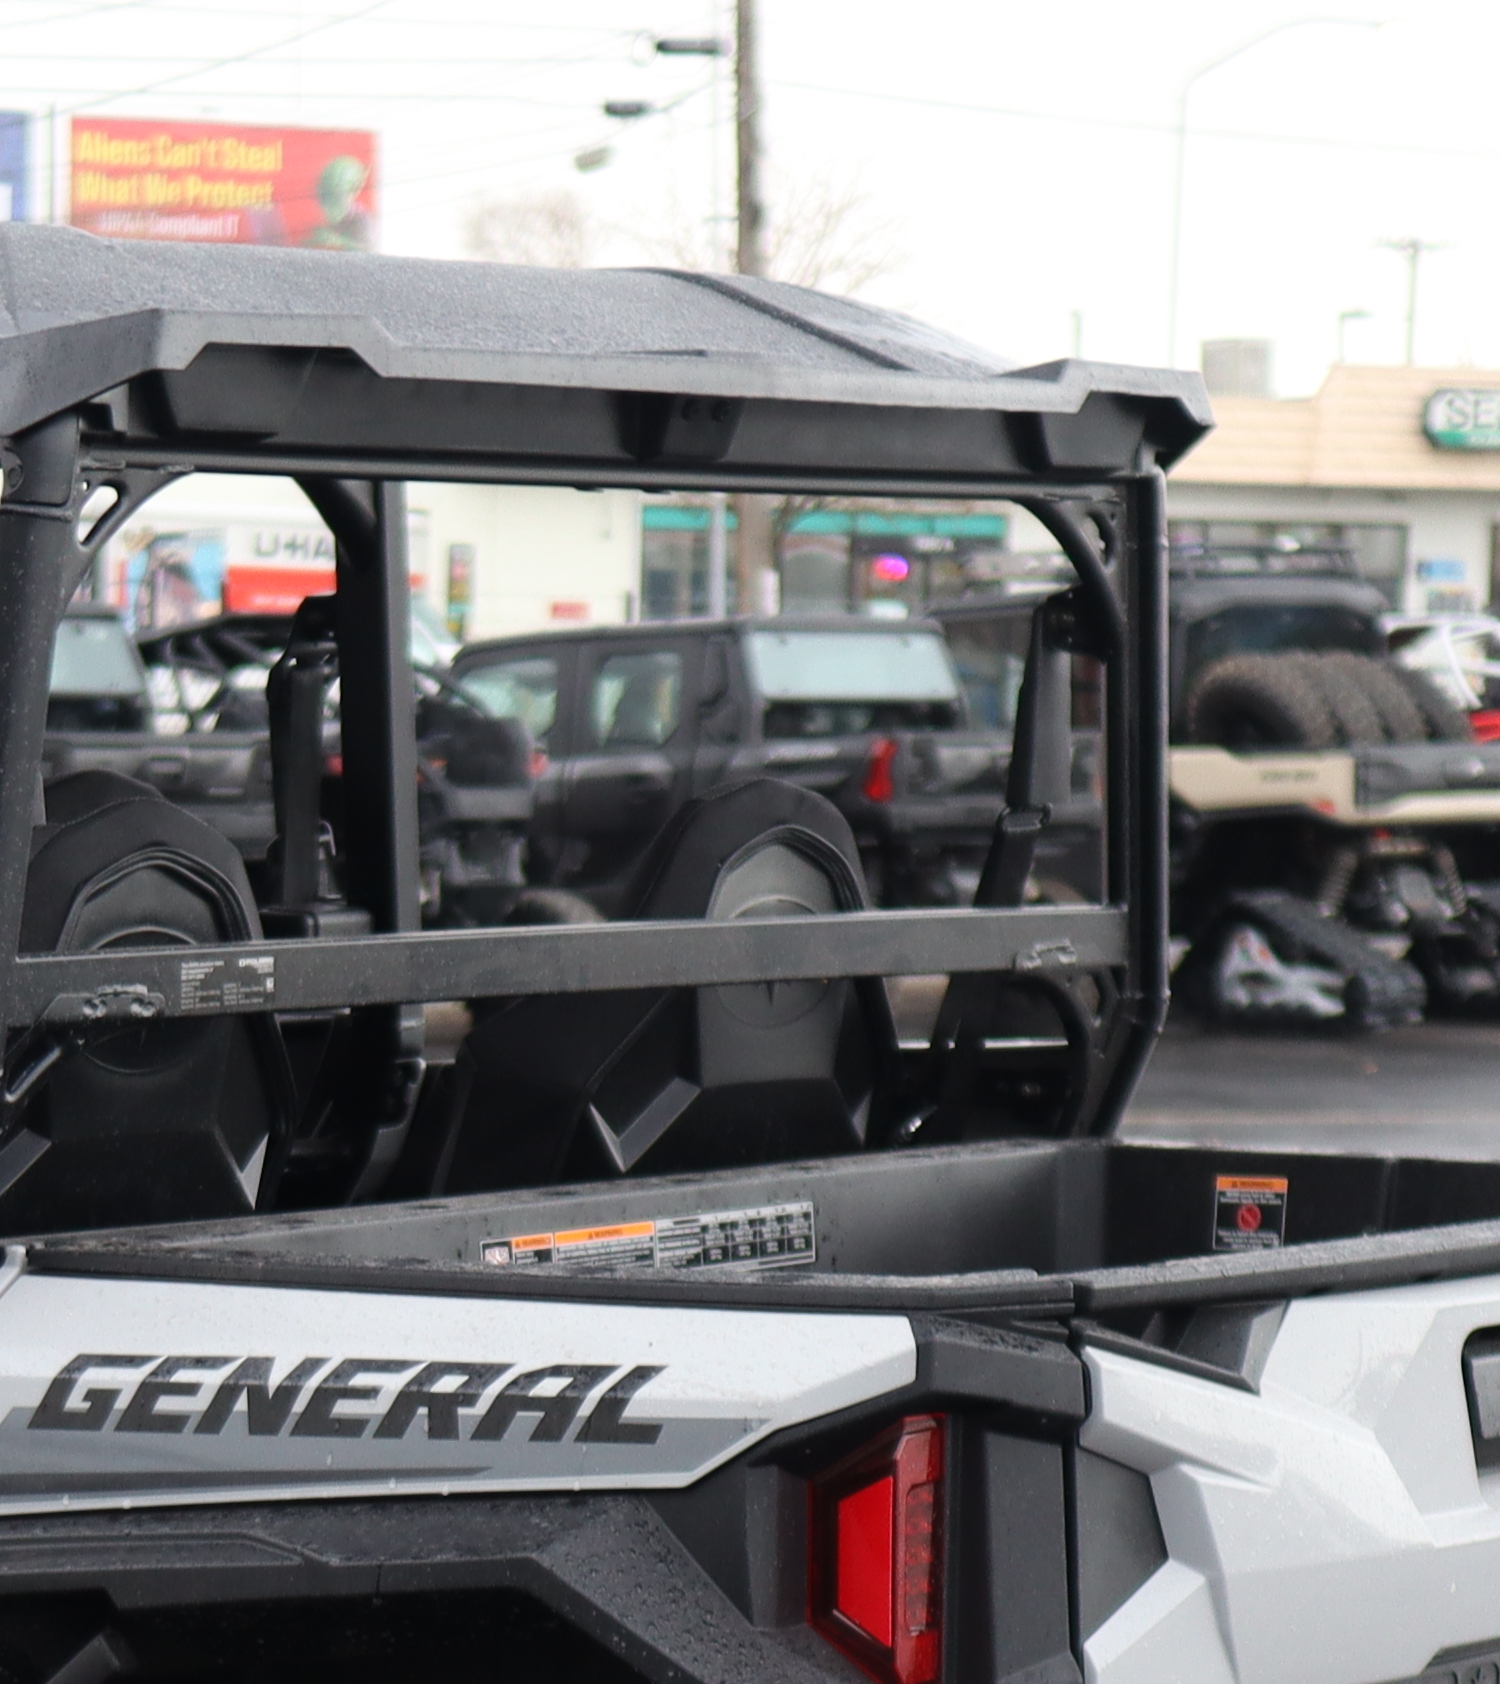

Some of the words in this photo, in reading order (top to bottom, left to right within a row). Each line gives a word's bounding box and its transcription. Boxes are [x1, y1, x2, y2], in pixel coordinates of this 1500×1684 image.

[77, 130, 151, 166] Aliens
[157, 133, 217, 168] Can't
[222, 137, 284, 171] Steal
[77, 170, 138, 205] What
[145, 173, 181, 206] We
[184, 176, 275, 209] Protect
[28, 1353, 669, 1445] GENERAL
